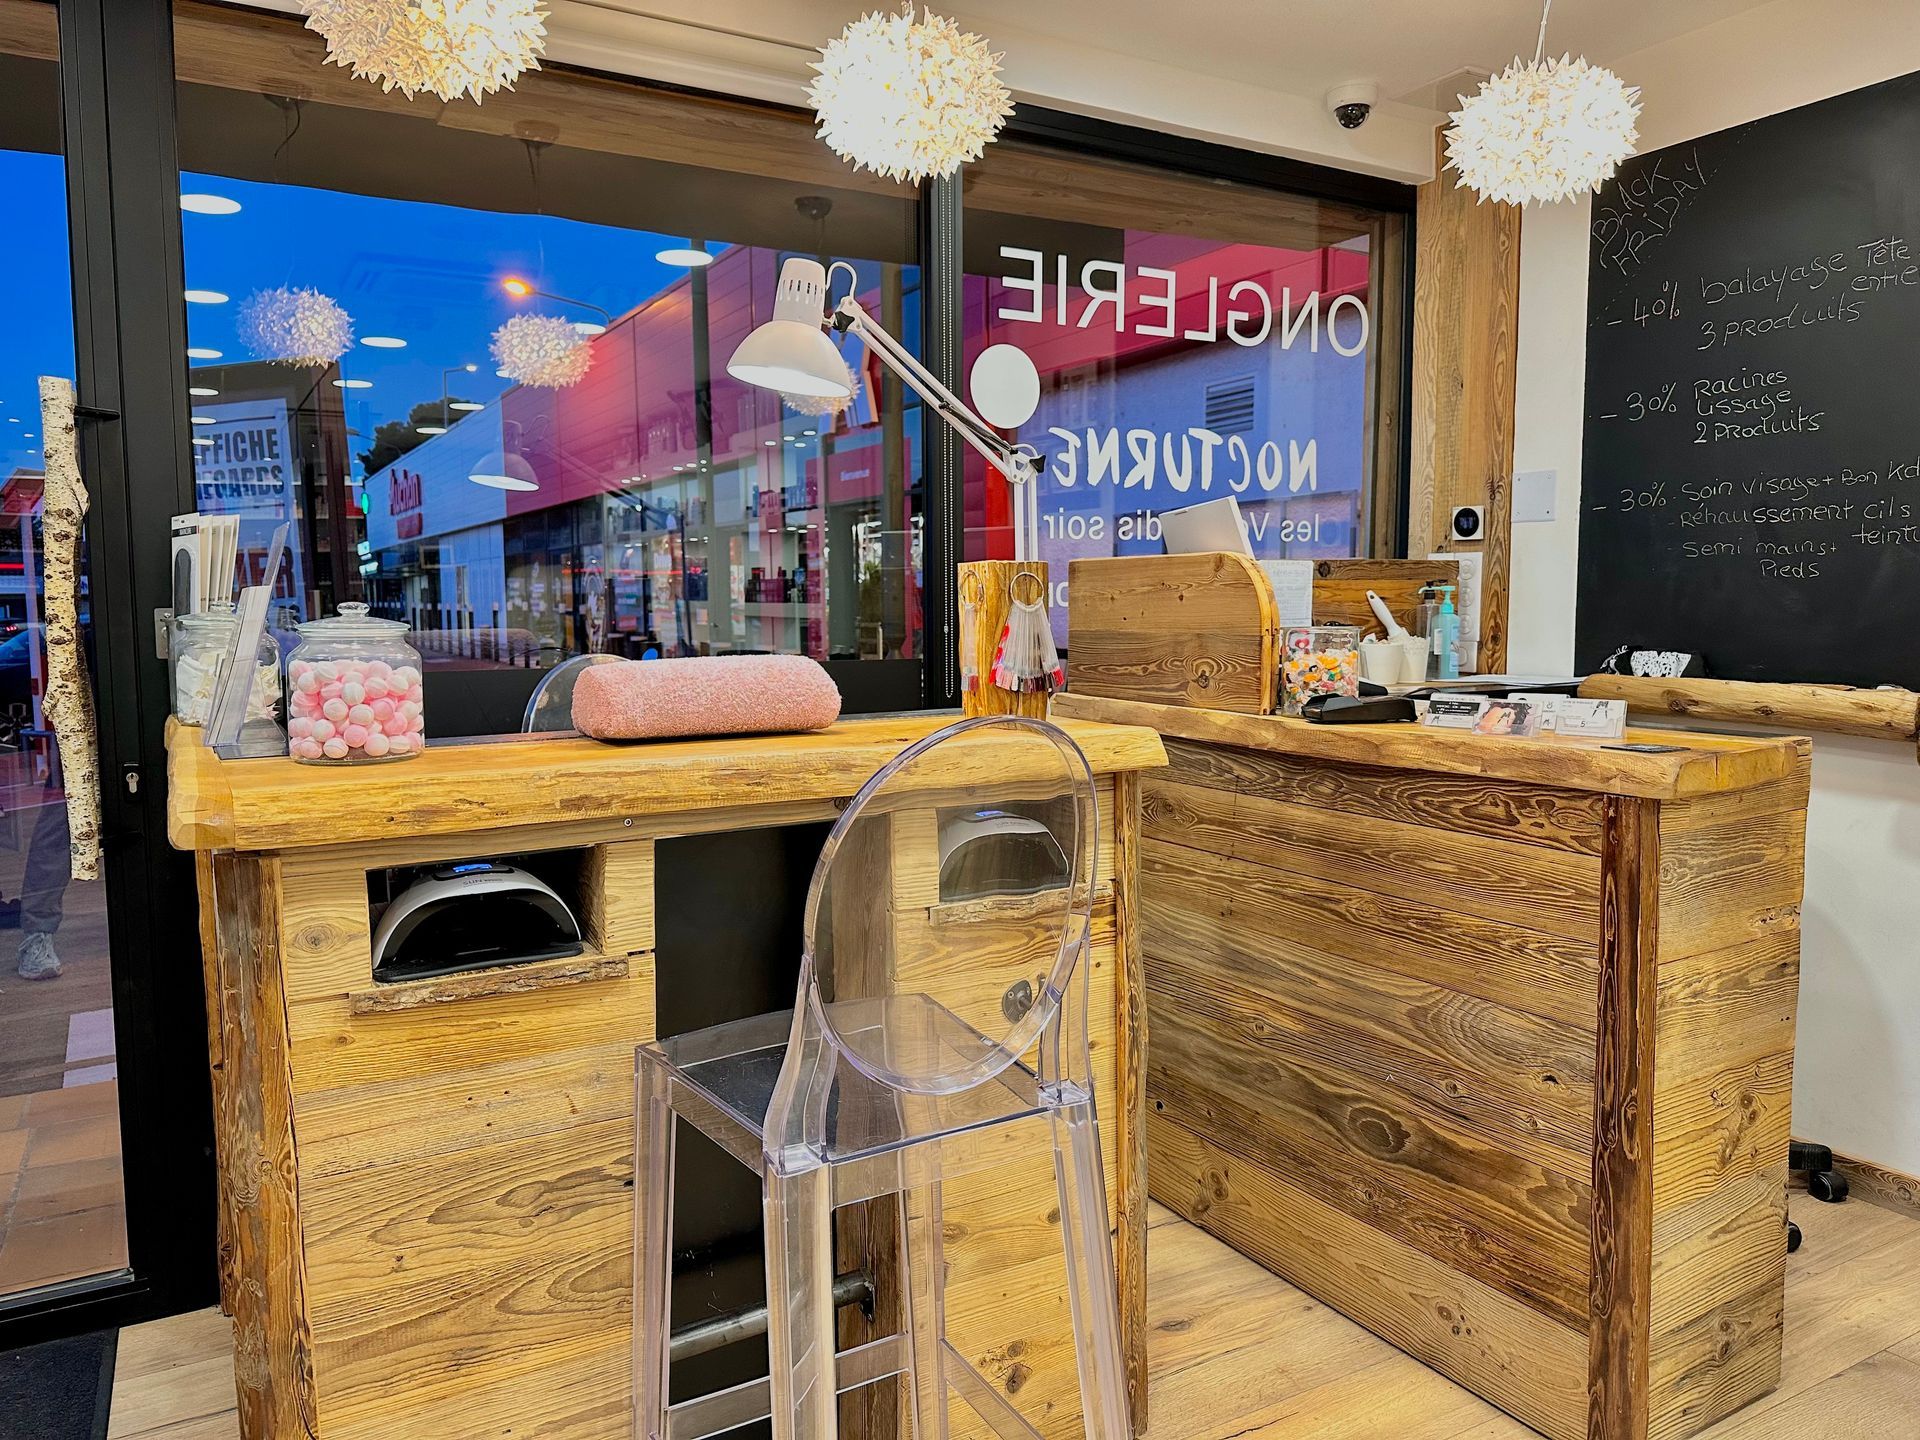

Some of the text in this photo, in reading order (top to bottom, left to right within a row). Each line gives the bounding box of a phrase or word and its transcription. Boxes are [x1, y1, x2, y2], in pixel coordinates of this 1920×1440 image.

[1701, 253, 1847, 304] balayage
[1697, 321, 1717, 350] 3
[1693, 367, 1788, 399] Racines
[195, 428, 280, 465] FFICHE
[1693, 421, 1708, 443] 2
[1682, 478, 1733, 501] Soin
[1841, 468, 1878, 486] Bon
[1863, 496, 1911, 519] cils
[1682, 537, 1742, 558] Semi
[1759, 559, 1820, 578] Pieds
